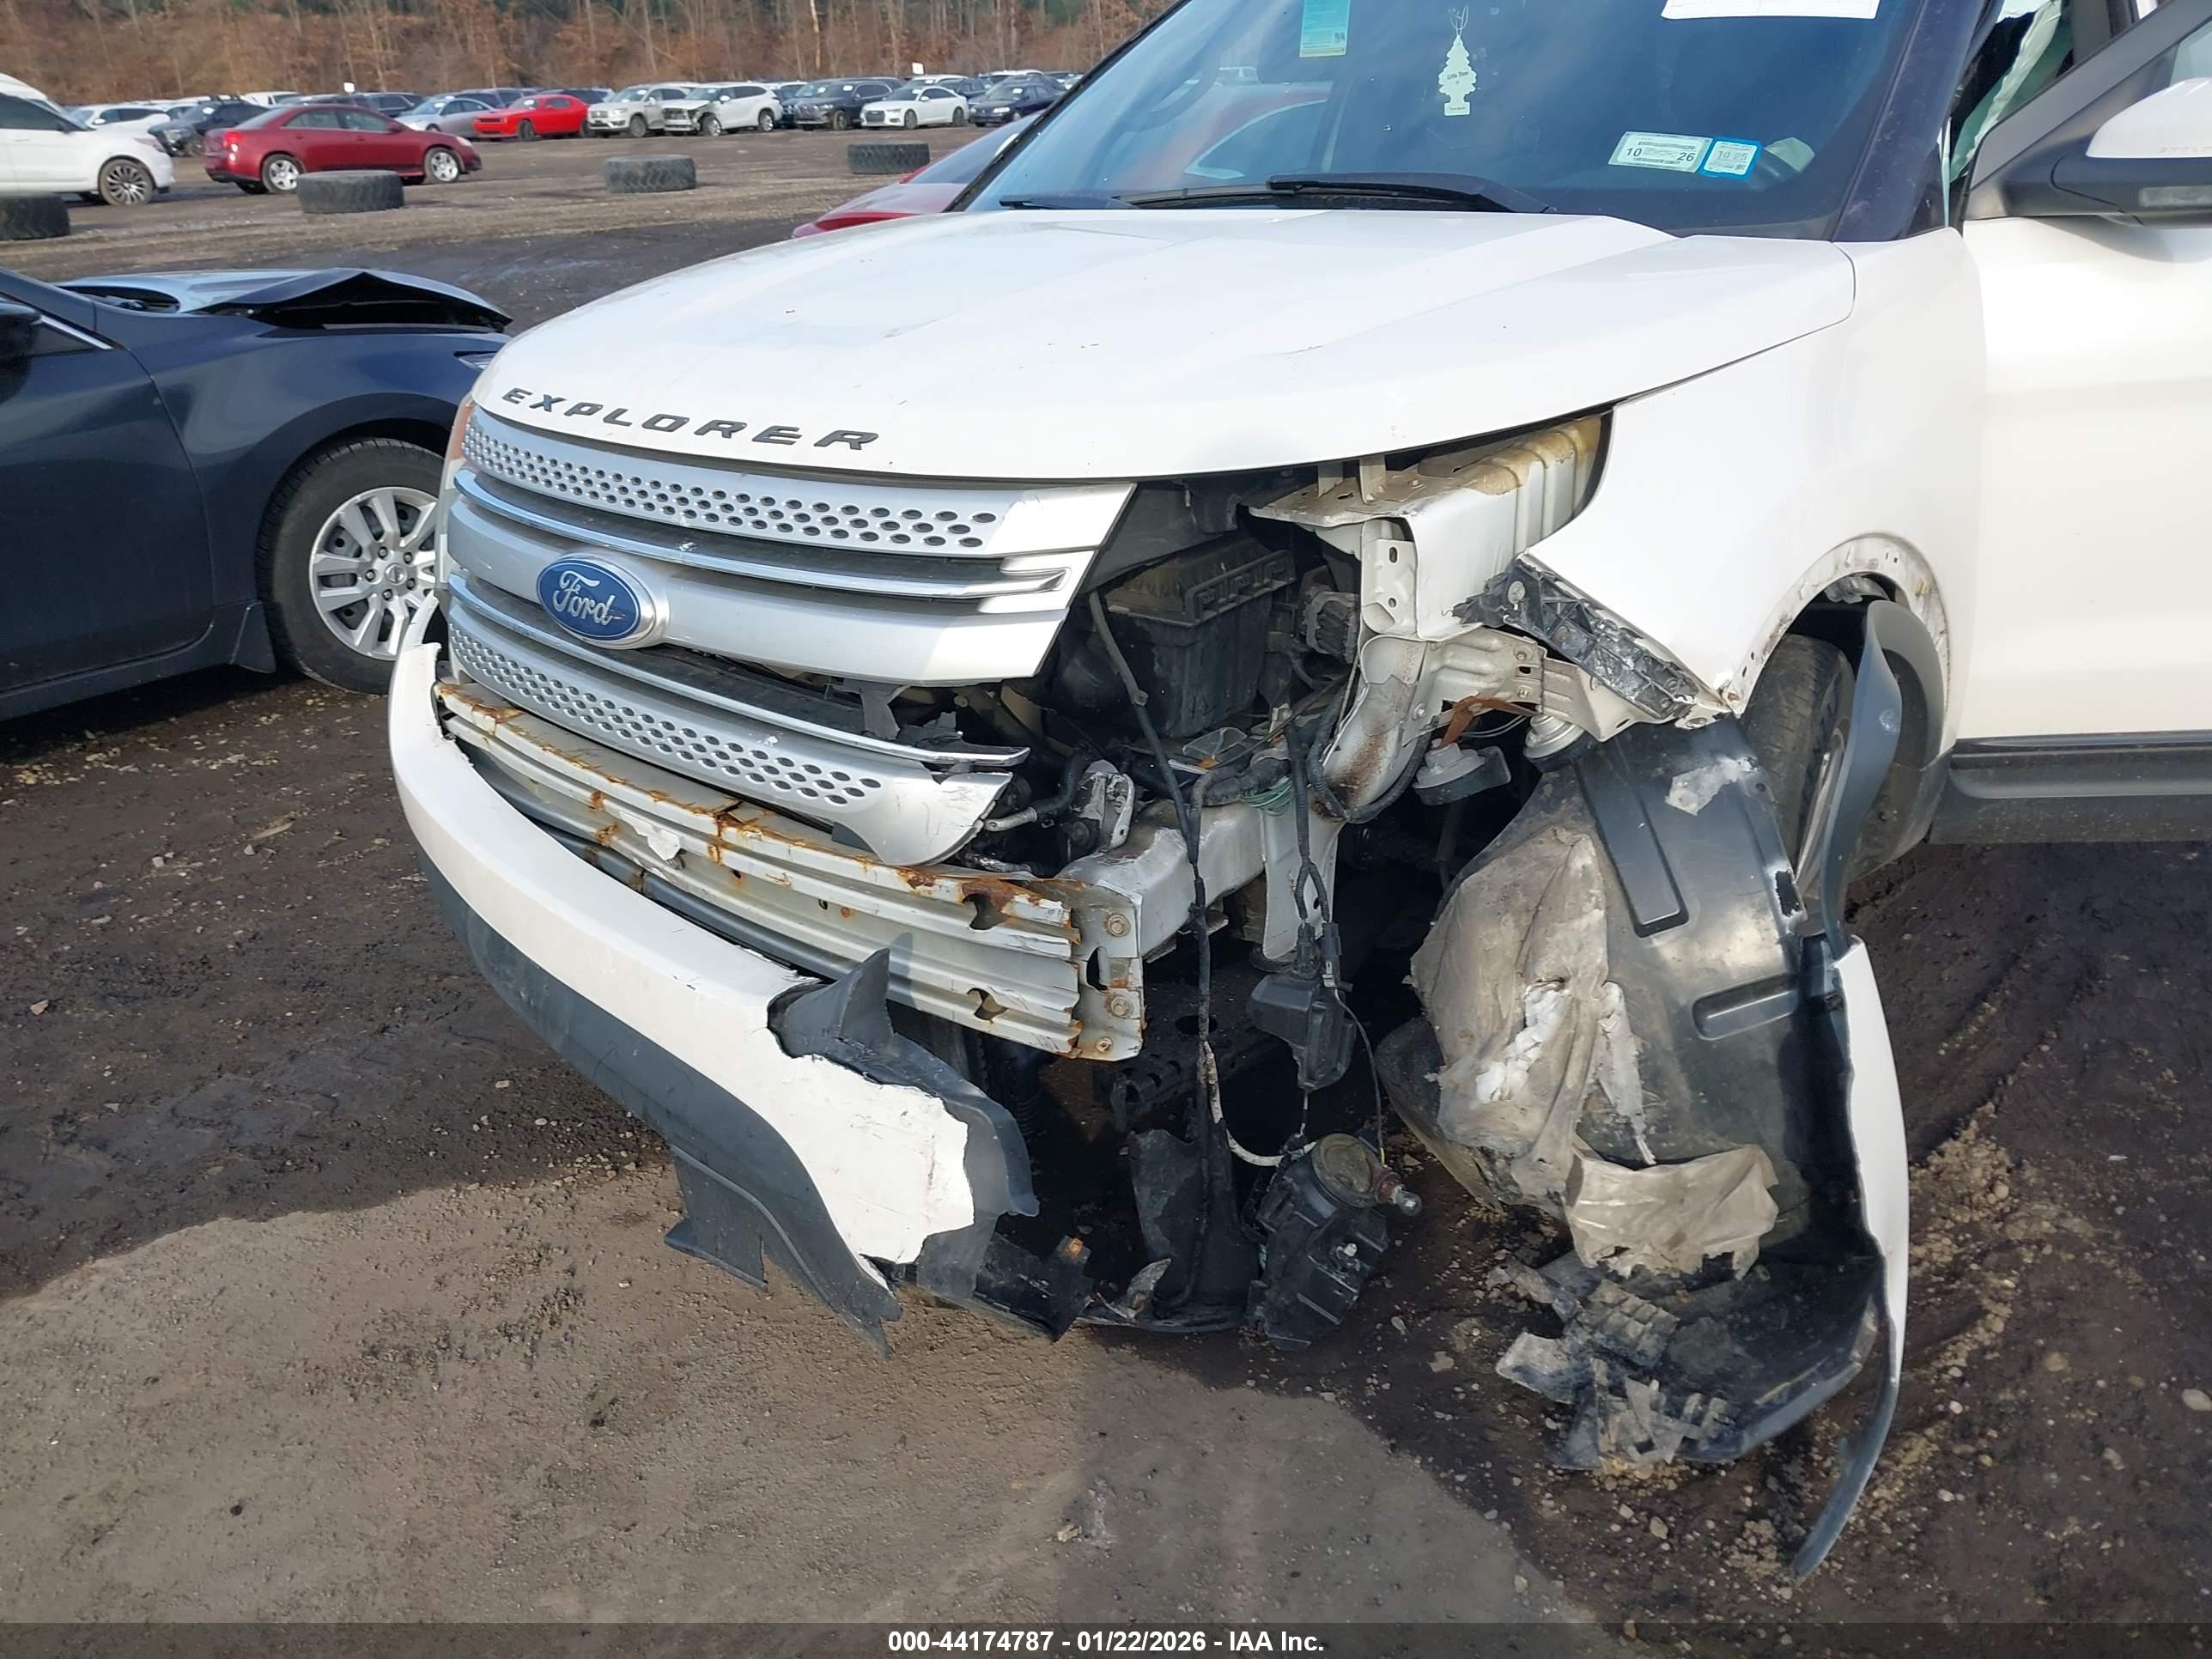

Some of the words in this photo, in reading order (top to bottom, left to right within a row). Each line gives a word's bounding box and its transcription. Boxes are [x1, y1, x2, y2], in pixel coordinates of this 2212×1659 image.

[1626, 148, 1642, 157] 10
[1676, 152, 1696, 161] 26
[501, 387, 879, 451] EXPLORER
[552, 570, 616, 626] Ford
